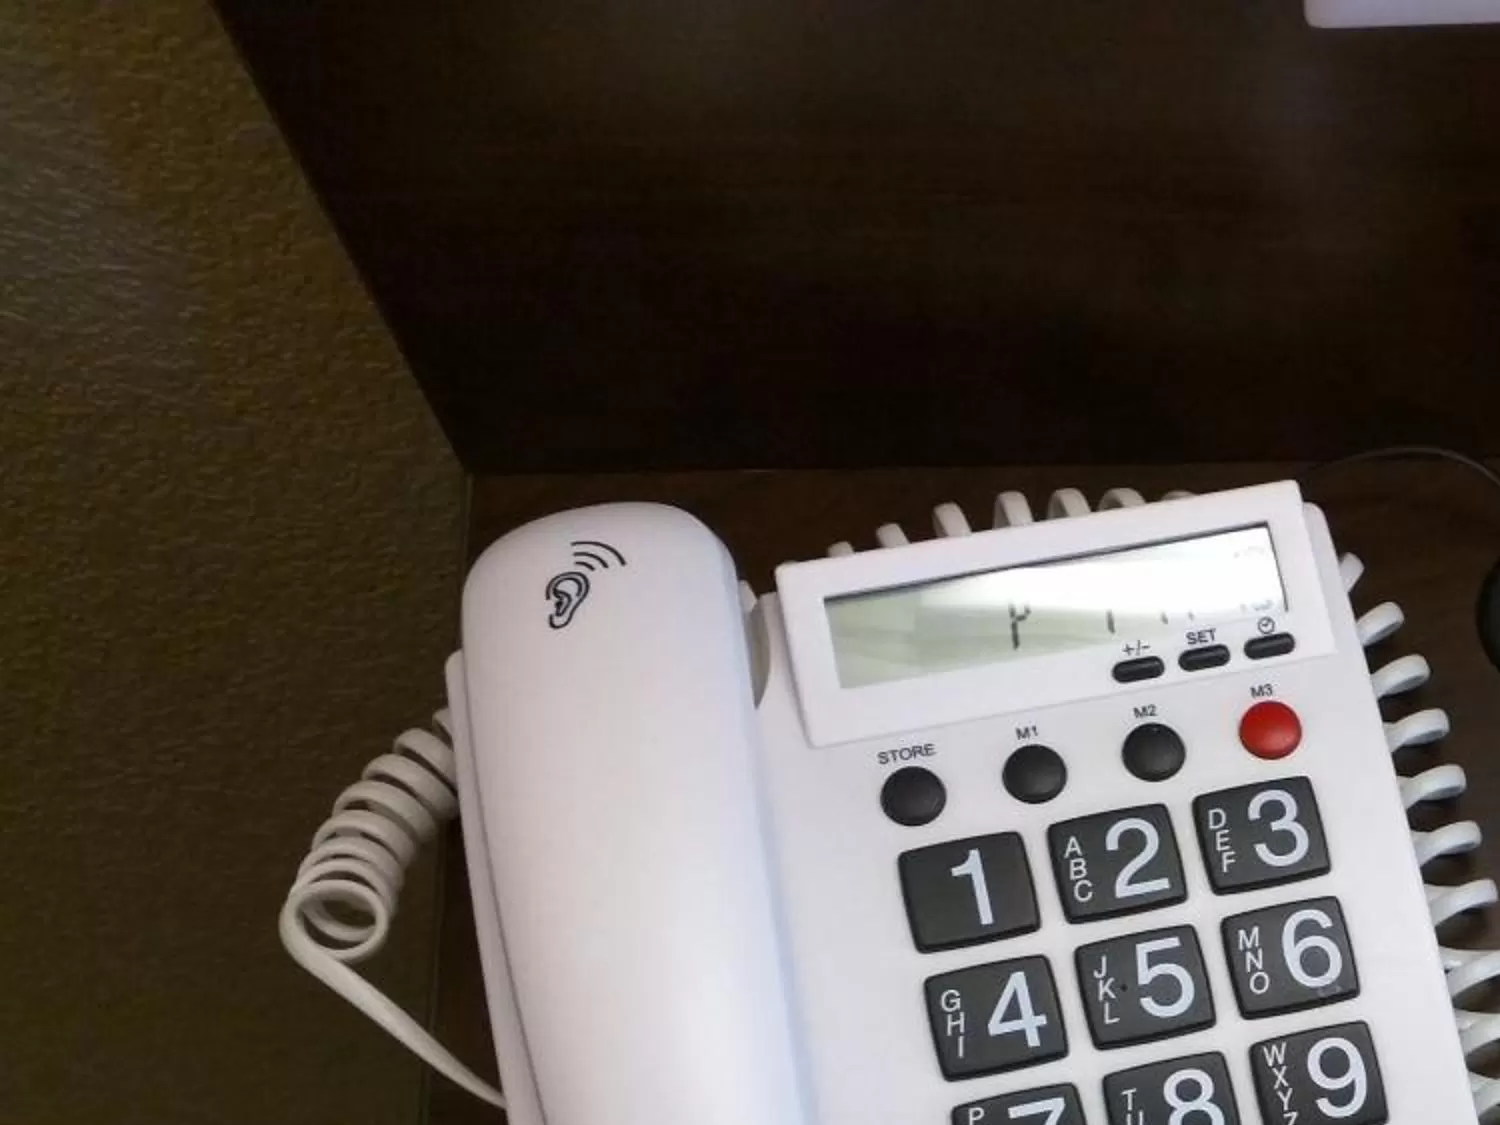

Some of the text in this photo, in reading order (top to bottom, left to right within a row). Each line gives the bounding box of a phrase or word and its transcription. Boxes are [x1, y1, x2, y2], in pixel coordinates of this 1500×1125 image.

[1186, 628, 1216, 645] SET
[1133, 704, 1157, 719] M2
[1250, 683, 1273, 698] M3
[877, 743, 936, 765] STORE
[1016, 726, 1038, 740] M1
[1105, 817, 1171, 899] 2
[1248, 789, 1309, 867] 3
[951, 849, 994, 926] 1
[1135, 936, 1195, 1018] 5
[1281, 909, 1342, 989] 6
[987, 971, 1047, 1047] 4
[1306, 1036, 1368, 1118] 9
